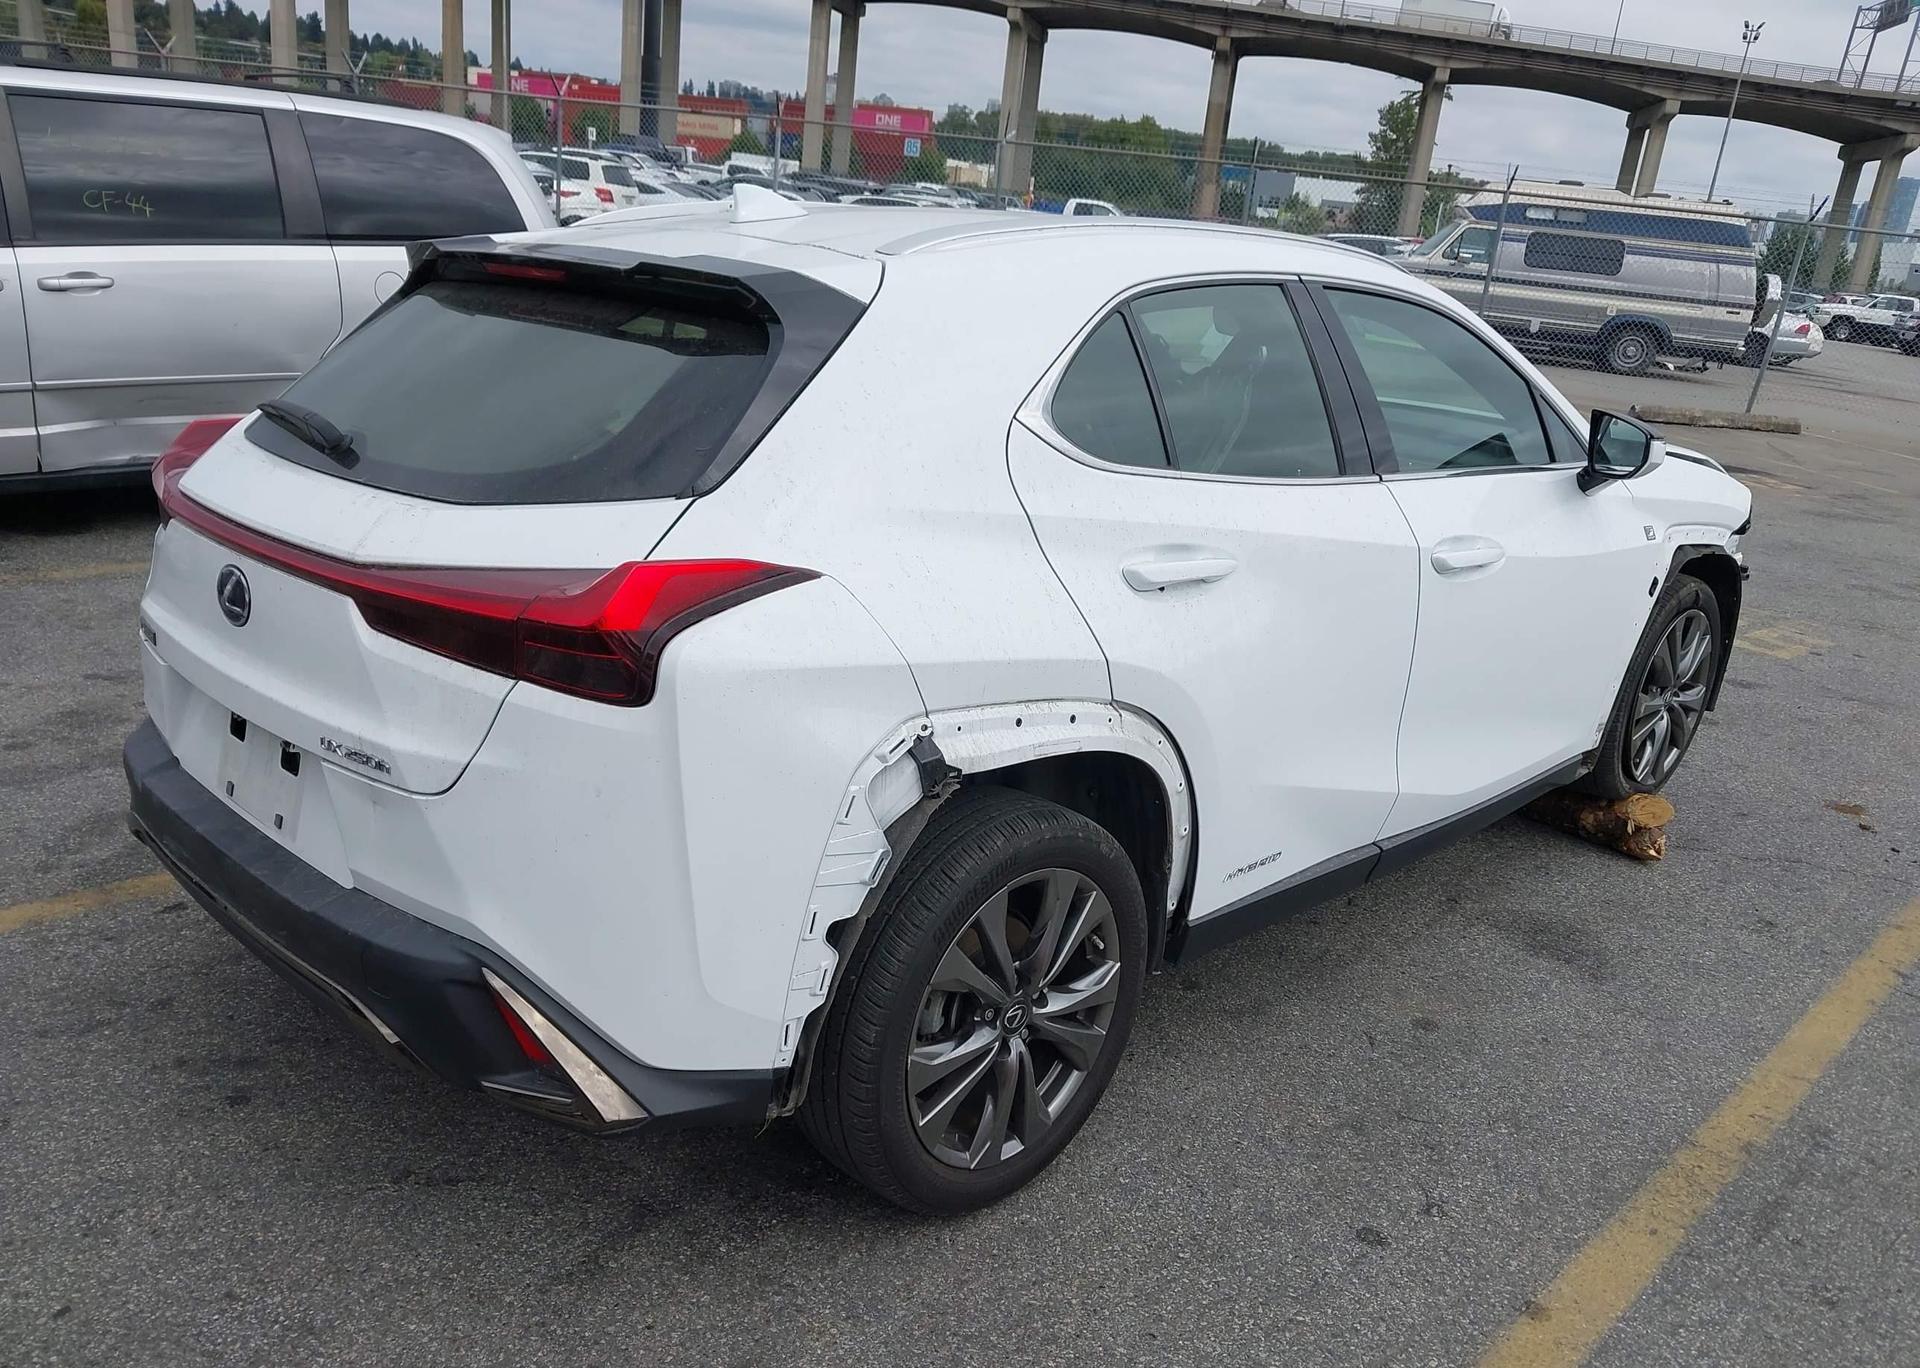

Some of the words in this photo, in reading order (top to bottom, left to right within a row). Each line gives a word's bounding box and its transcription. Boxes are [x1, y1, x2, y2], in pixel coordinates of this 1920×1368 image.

[511, 78, 529, 92] NE
[875, 114, 902, 126] ONE
[906, 140, 919, 154] 85
[83, 189, 156, 218] CF-44
